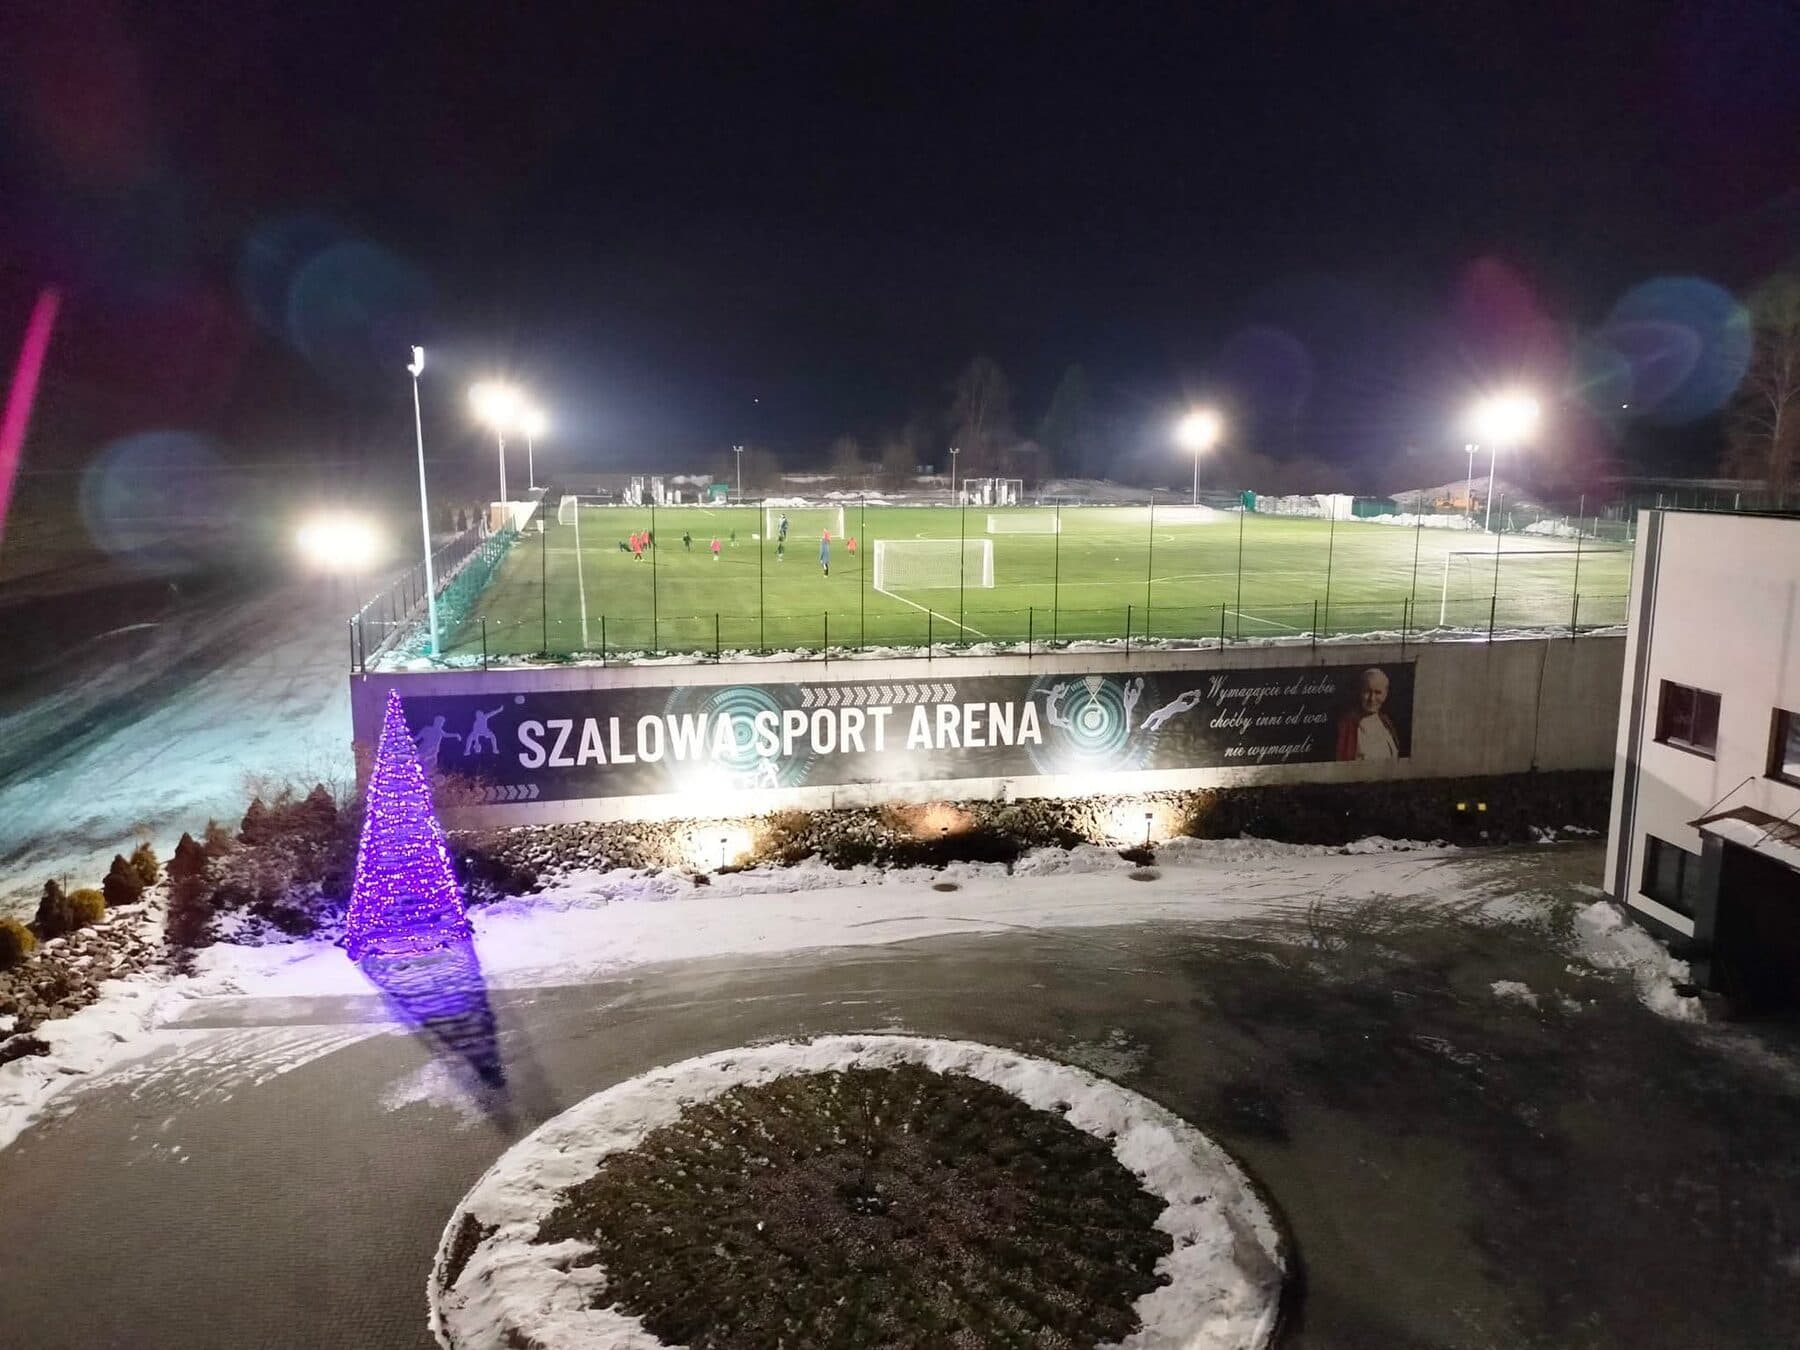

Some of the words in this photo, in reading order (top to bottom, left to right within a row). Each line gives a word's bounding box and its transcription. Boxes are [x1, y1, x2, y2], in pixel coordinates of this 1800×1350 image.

[1284, 676, 1304, 695] od
[1302, 675, 1336, 694] siebie
[1210, 707, 1252, 735] choćby
[1255, 712, 1285, 726] inni
[1285, 704, 1304, 725] od
[1303, 712, 1328, 724] was
[517, 711, 738, 769] SZALOWA
[755, 706, 893, 757] SPORT
[907, 701, 1043, 750] ARENA
[1224, 743, 1246, 757] nie
[1247, 736, 1314, 763] wymagali
